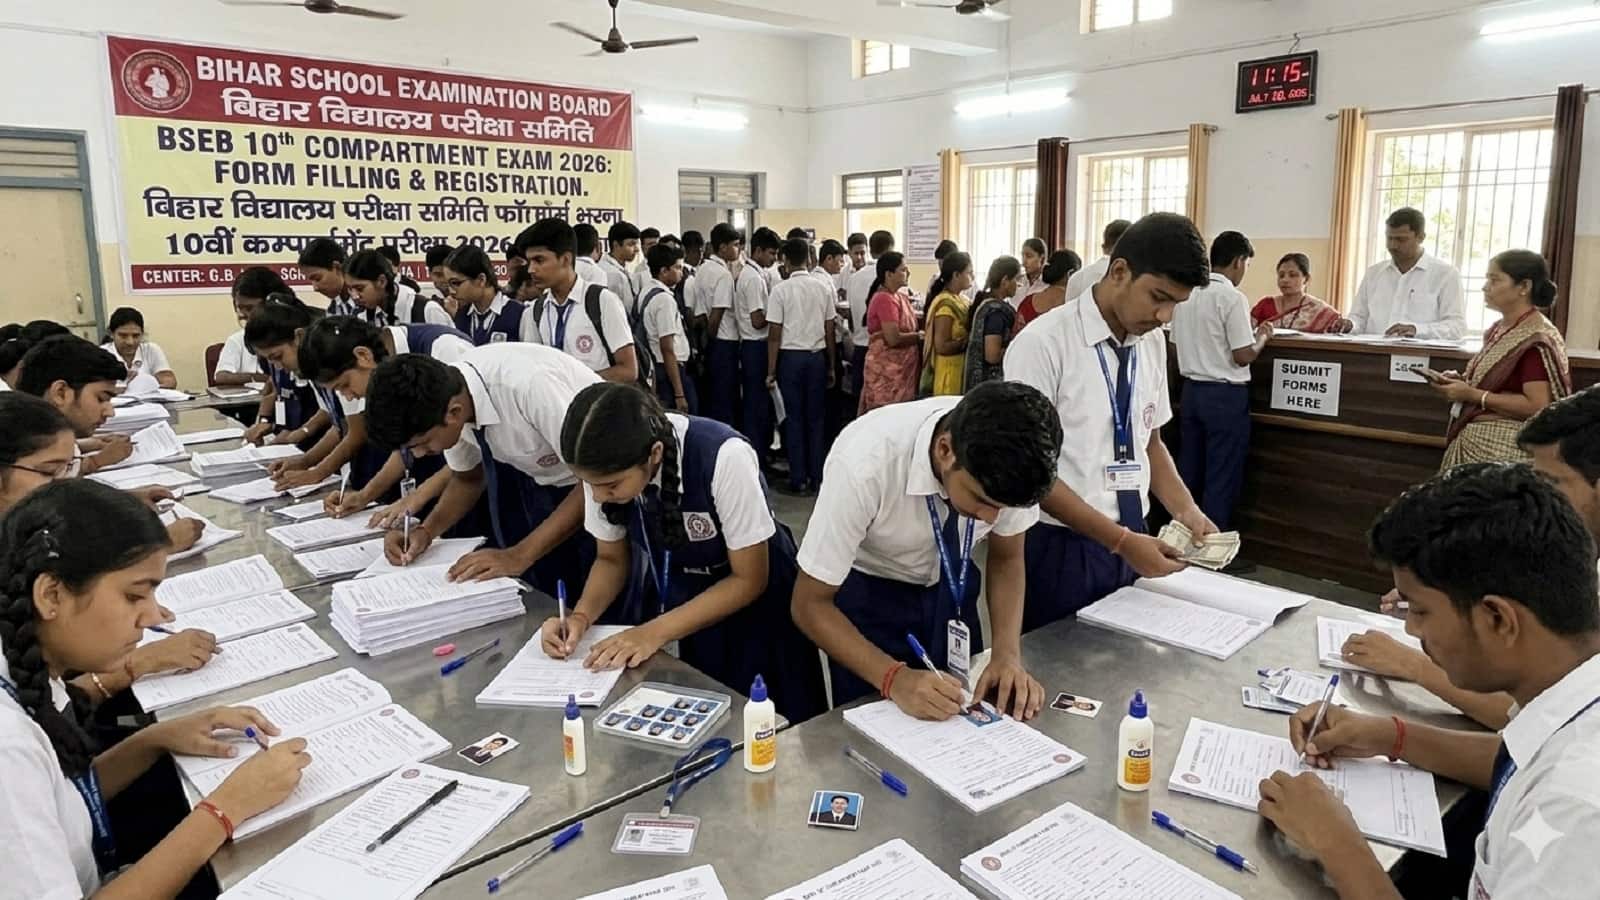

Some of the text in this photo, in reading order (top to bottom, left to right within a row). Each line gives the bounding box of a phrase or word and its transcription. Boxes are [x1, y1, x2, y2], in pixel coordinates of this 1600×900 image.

[196, 56, 282, 87] BIHAR
[290, 69, 391, 96] SCHOOL
[397, 76, 543, 111] EXAMINATION
[549, 93, 611, 117] BOARD
[220, 87, 594, 144] बिहार विद्यालय परीक्षा समिति
[157, 125, 612, 174] BSEB 10th COMPARTMENT EXAM 2026:
[215, 160, 589, 197] FORM FILLING & REGISTRATION.
[143, 187, 225, 220] बिहार
[230, 190, 336, 221] विद्यालय
[343, 193, 410, 222] परीक्षा
[418, 196, 489, 223] समिति
[142, 268, 205, 284] CENTER:
[1281, 363, 1332, 377] SUBMIT
[1282, 379, 1328, 394] FORMS
[1286, 396, 1321, 409] HERE
